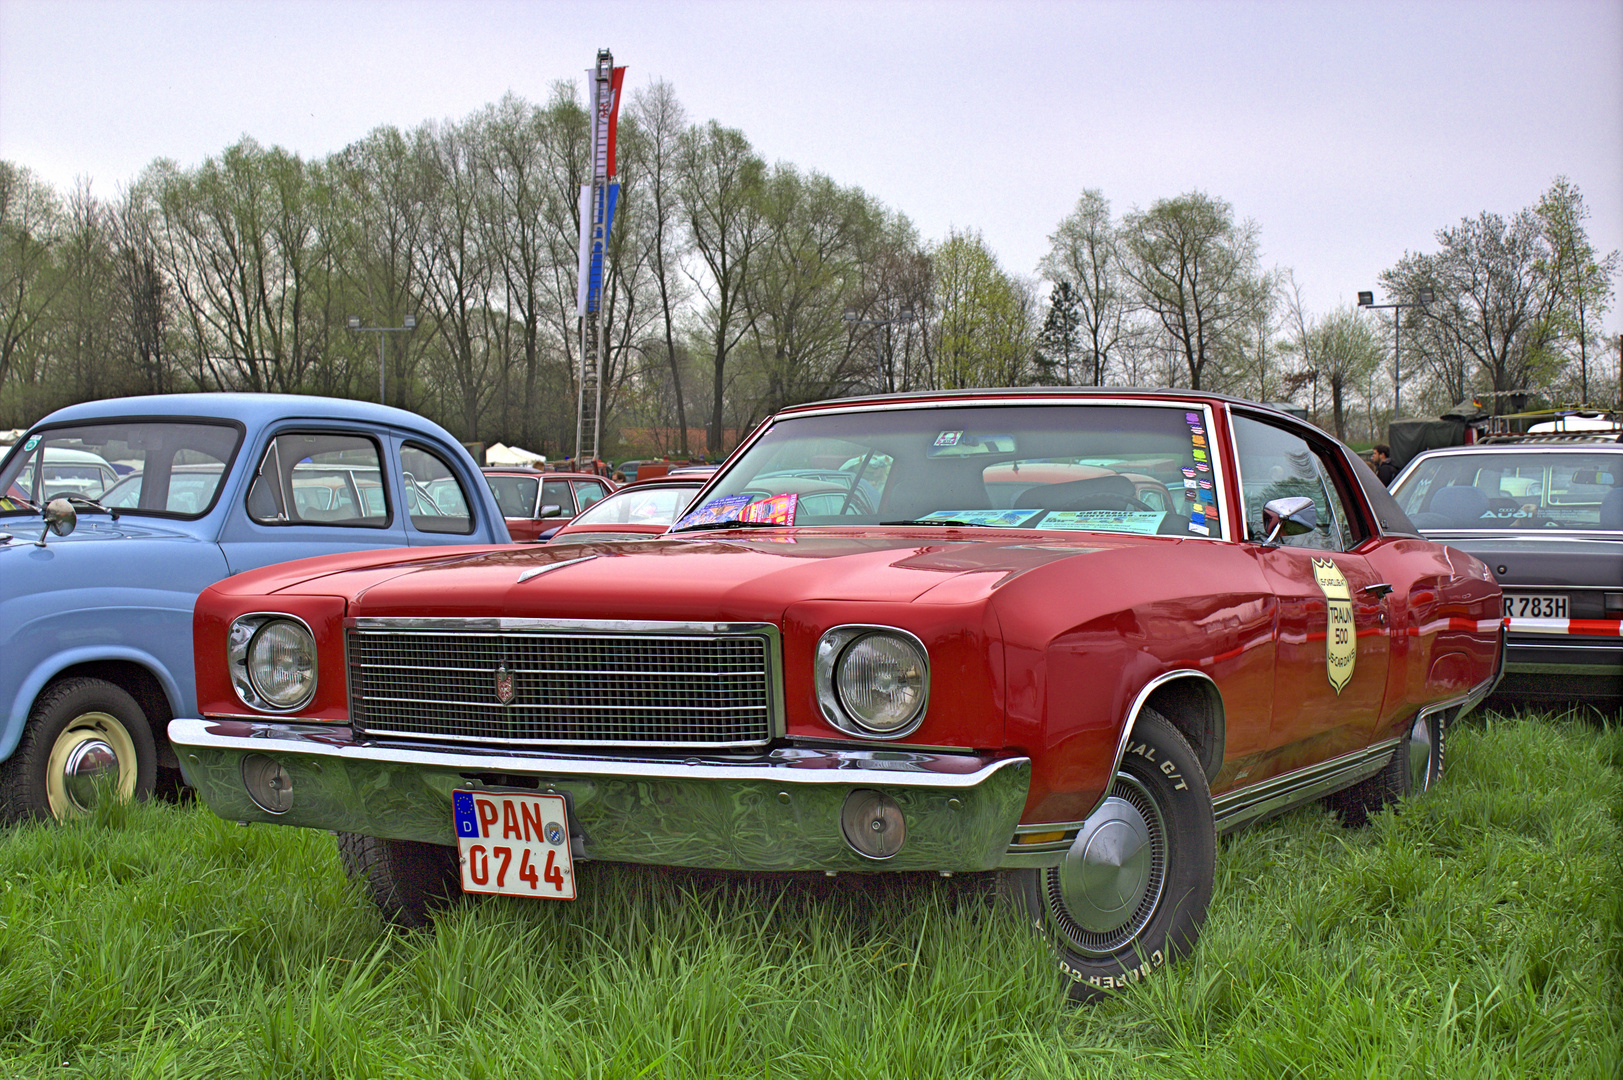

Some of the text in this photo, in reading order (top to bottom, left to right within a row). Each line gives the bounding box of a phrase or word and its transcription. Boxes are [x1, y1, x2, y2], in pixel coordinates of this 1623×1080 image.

[1330, 607, 1352, 624] TRAUN
[1519, 597, 1567, 617] 783H
[1335, 628, 1349, 645] 500
[1160, 760, 1188, 790] G/T
[463, 821, 472, 832] D
[475, 799, 544, 843] PAN
[469, 844, 564, 891] 0744
